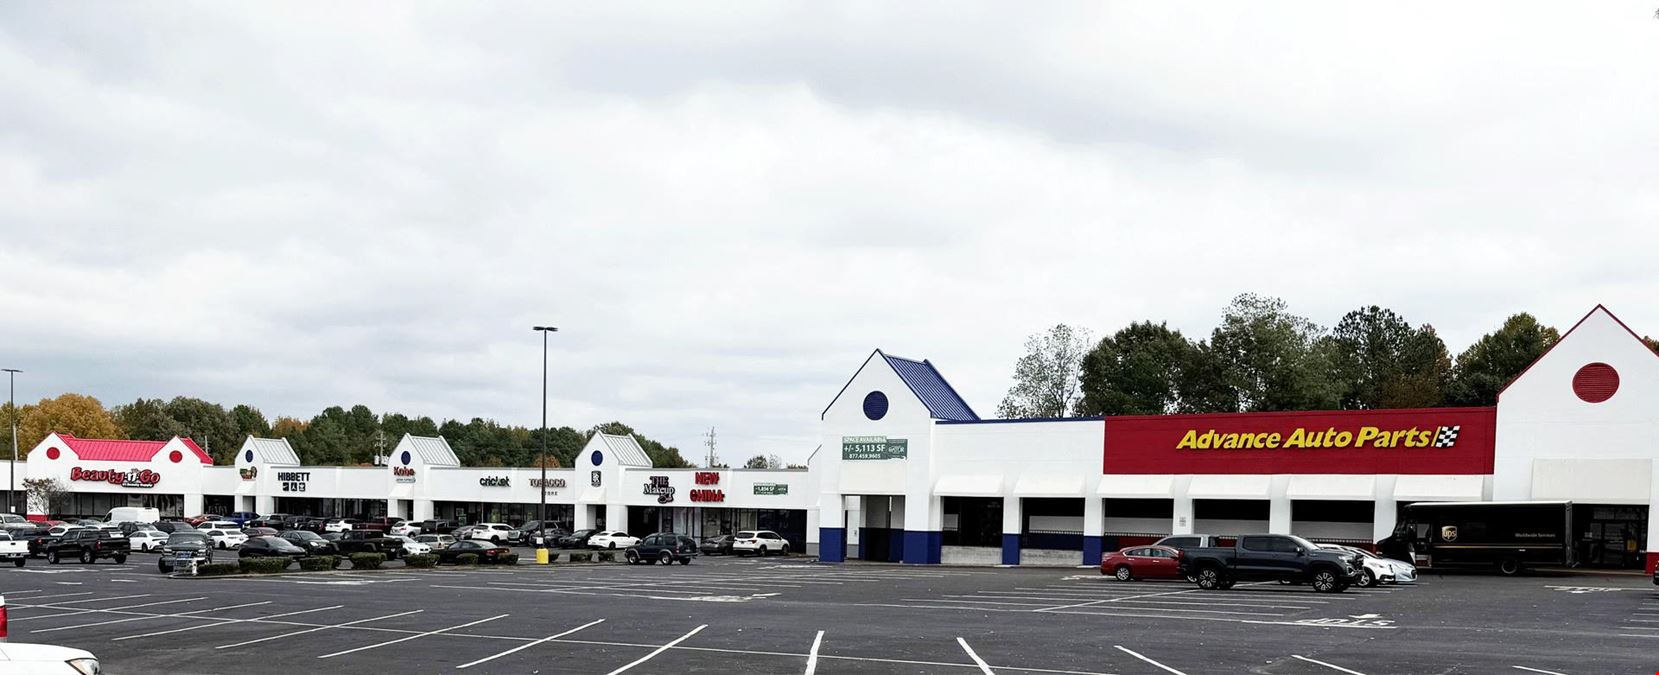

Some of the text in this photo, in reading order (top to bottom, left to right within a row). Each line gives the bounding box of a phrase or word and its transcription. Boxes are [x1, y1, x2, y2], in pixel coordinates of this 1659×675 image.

[1175, 426, 1432, 449] Advance Auto Parts
[855, 444, 875, 452] 5,113
[876, 444, 886, 452] SF
[70, 467, 125, 484] Beauty
[140, 469, 161, 484] Go
[277, 472, 310, 481] HIBBETT
[479, 476, 511, 487] cricket
[649, 476, 669, 486] THE
[695, 472, 720, 485] NEW
[643, 483, 675, 497] Makeup
[690, 489, 725, 502] CHINA
